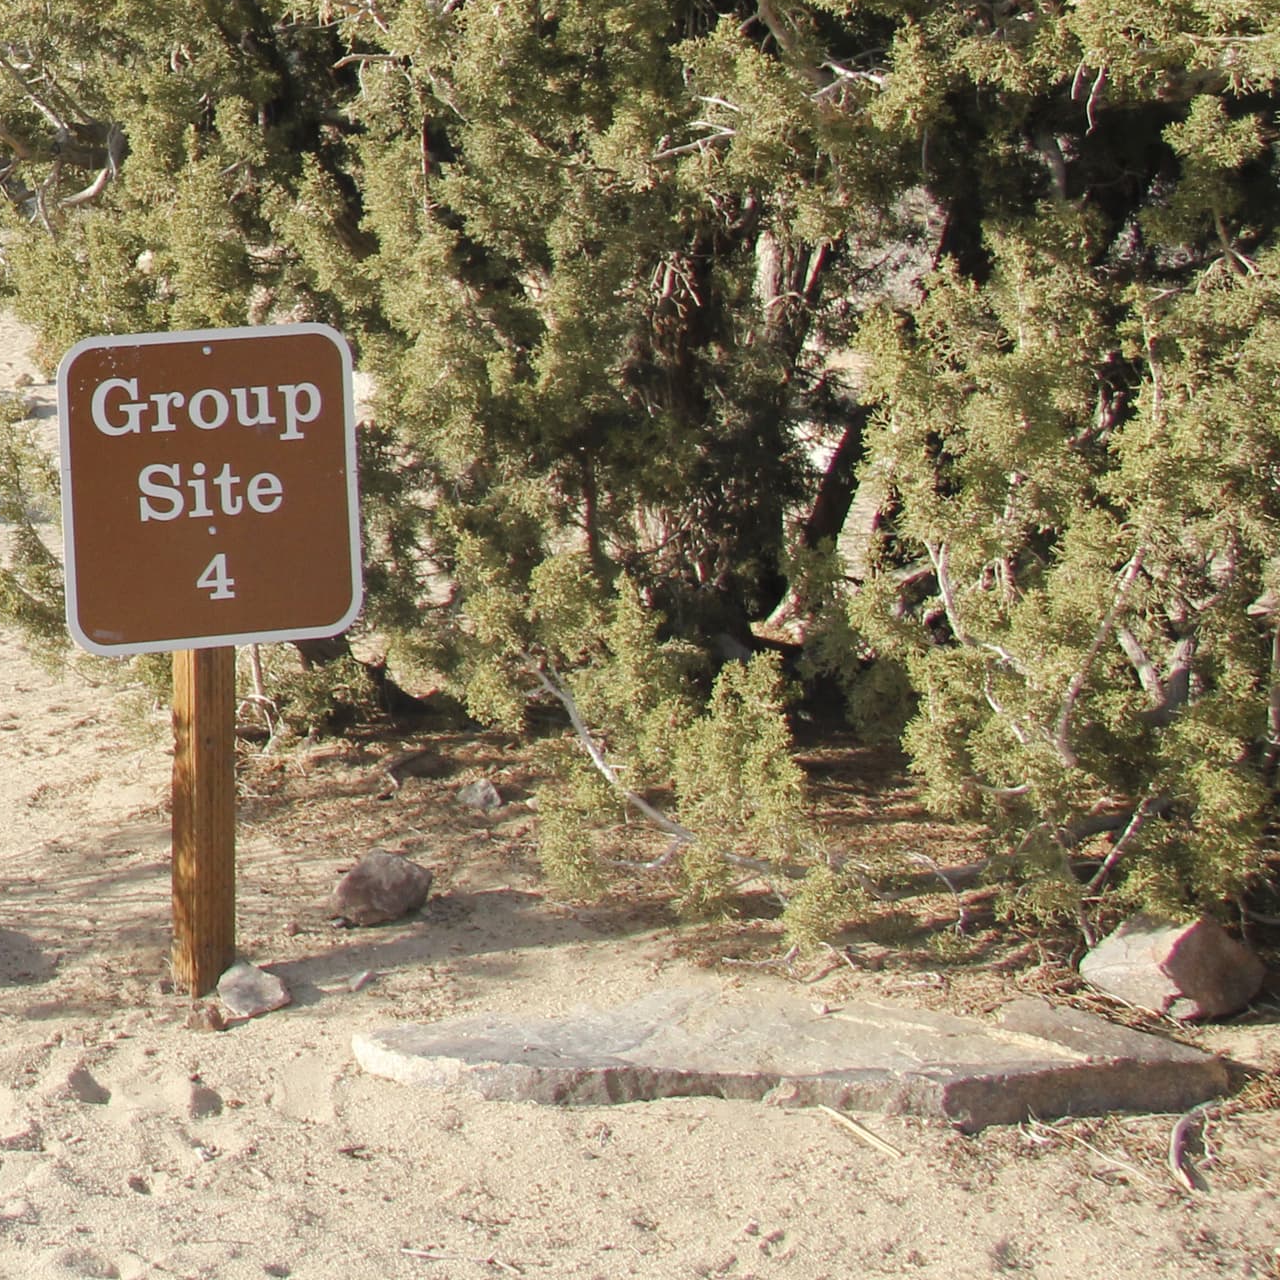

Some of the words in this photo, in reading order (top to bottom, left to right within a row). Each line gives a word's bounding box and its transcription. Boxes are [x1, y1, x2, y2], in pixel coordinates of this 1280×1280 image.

[91, 378, 322, 440] Group
[138, 462, 283, 522] Site
[196, 553, 235, 600] 4
